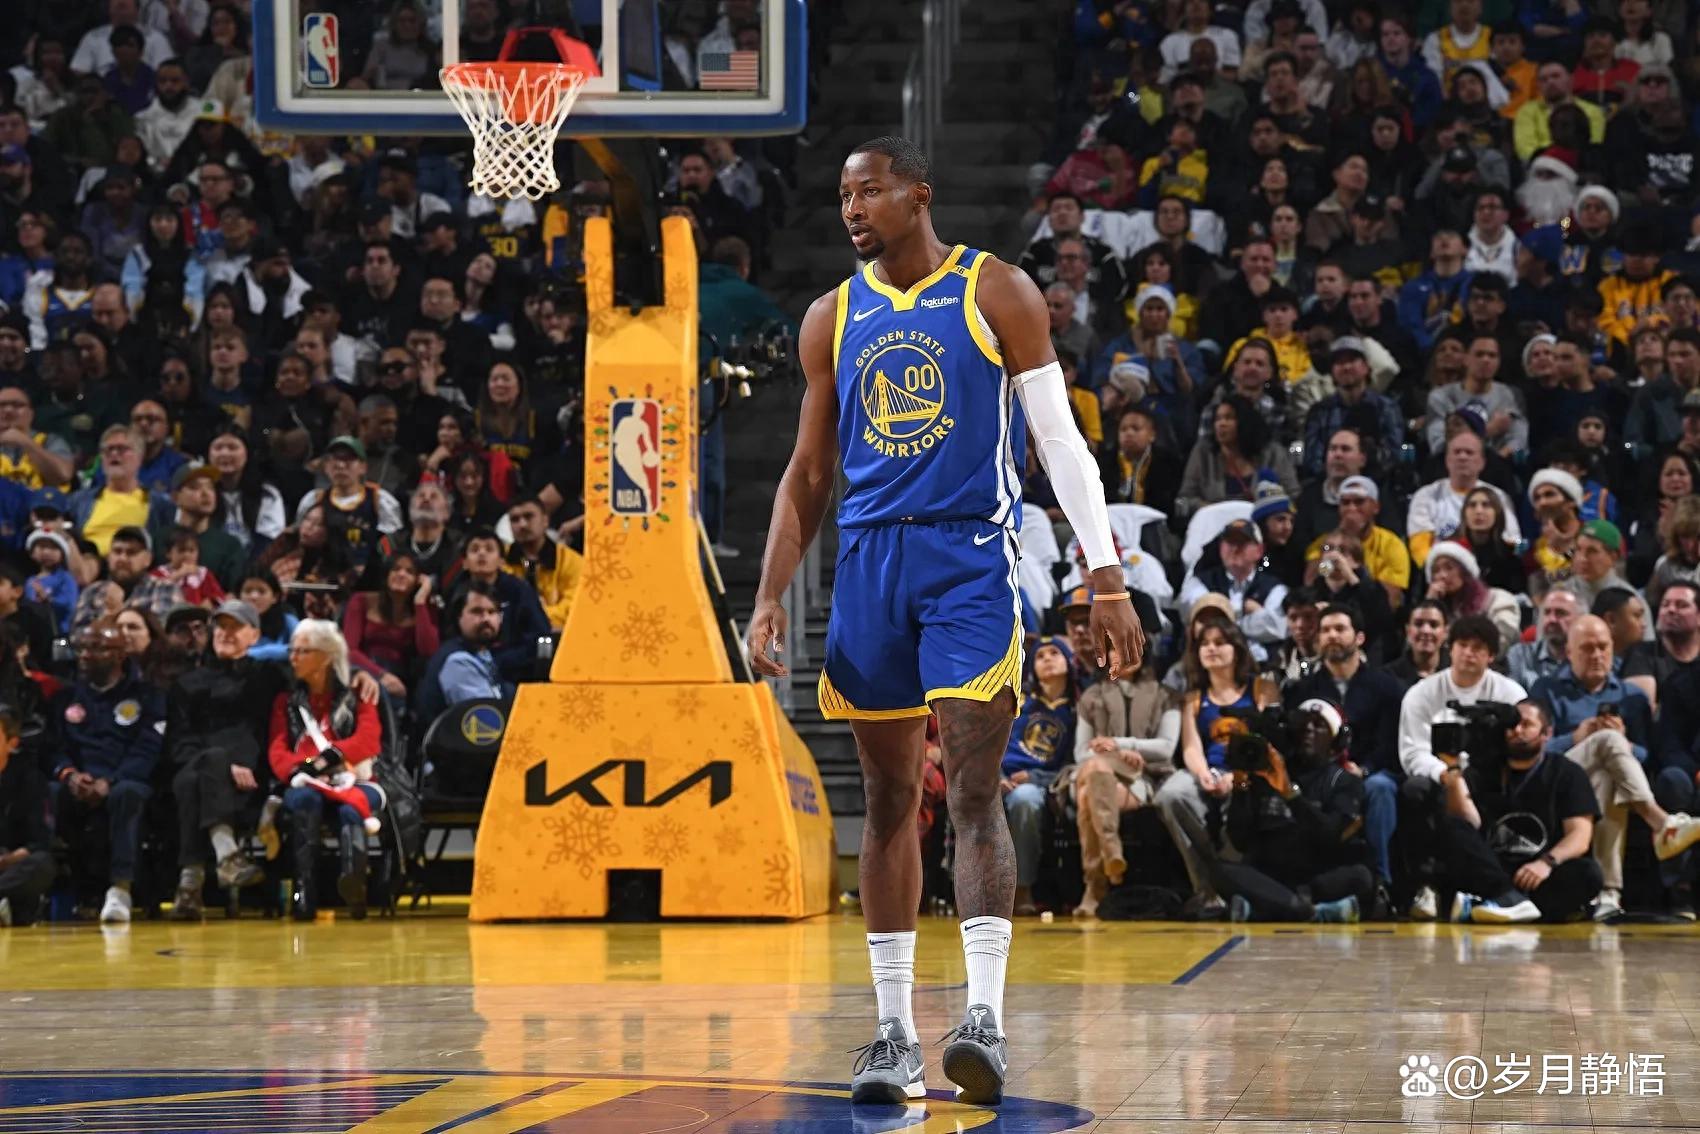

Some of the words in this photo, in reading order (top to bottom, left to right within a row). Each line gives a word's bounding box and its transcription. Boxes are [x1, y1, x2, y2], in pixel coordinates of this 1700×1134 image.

[920, 296, 959, 308] Rakuten
[856, 331, 904, 368] GOLDEN
[909, 331, 945, 357] STATE
[905, 365, 935, 392] 00
[863, 415, 955, 457] WARRIORS
[616, 489, 641, 509] NBA
[525, 759, 732, 808] KIA
